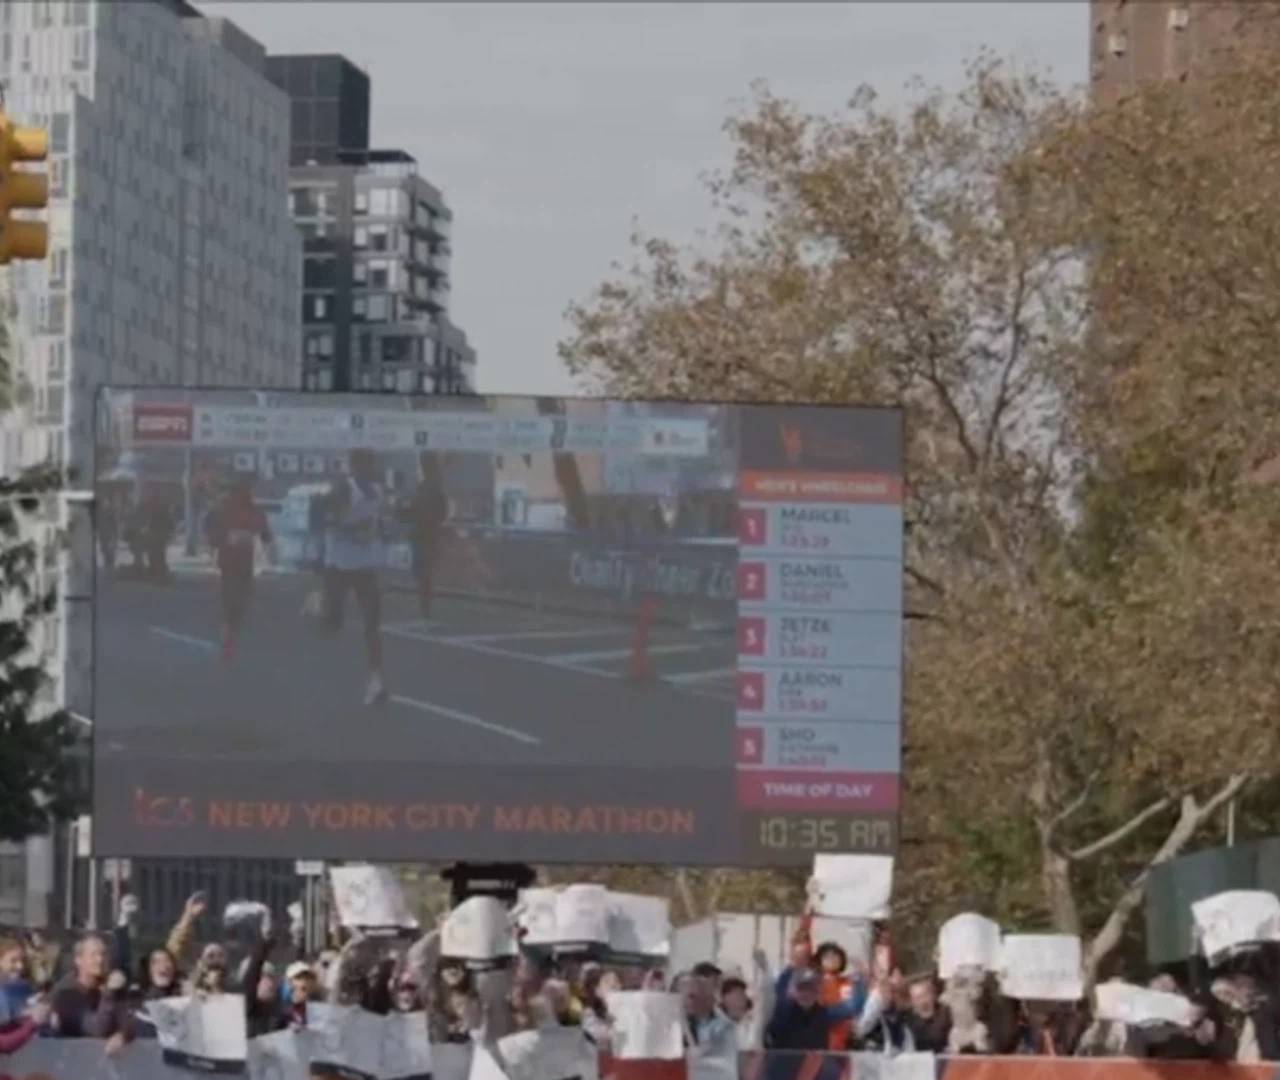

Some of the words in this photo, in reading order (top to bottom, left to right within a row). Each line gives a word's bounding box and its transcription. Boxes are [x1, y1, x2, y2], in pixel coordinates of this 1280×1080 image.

[136, 414, 189, 434] ESPN
[781, 508, 852, 525] MARCEL
[745, 518, 757, 539] 1
[780, 562, 845, 579] DANIEL
[744, 571, 756, 591] 2
[780, 617, 831, 633] JETZE
[744, 629, 757, 648] 3
[780, 671, 843, 687] AARON
[742, 685, 756, 699] 4
[779, 728, 817, 742] SHO
[743, 740, 756, 756] 5
[763, 783, 805, 797] TIME
[810, 783, 832, 797] OF
[834, 783, 875, 798] DAY
[208, 801, 291, 829] NEW
[302, 801, 396, 831] YORK
[406, 803, 482, 831] CITY
[494, 804, 696, 834] MARATHON
[759, 817, 839, 849] 10:35
[849, 820, 892, 848] AM
